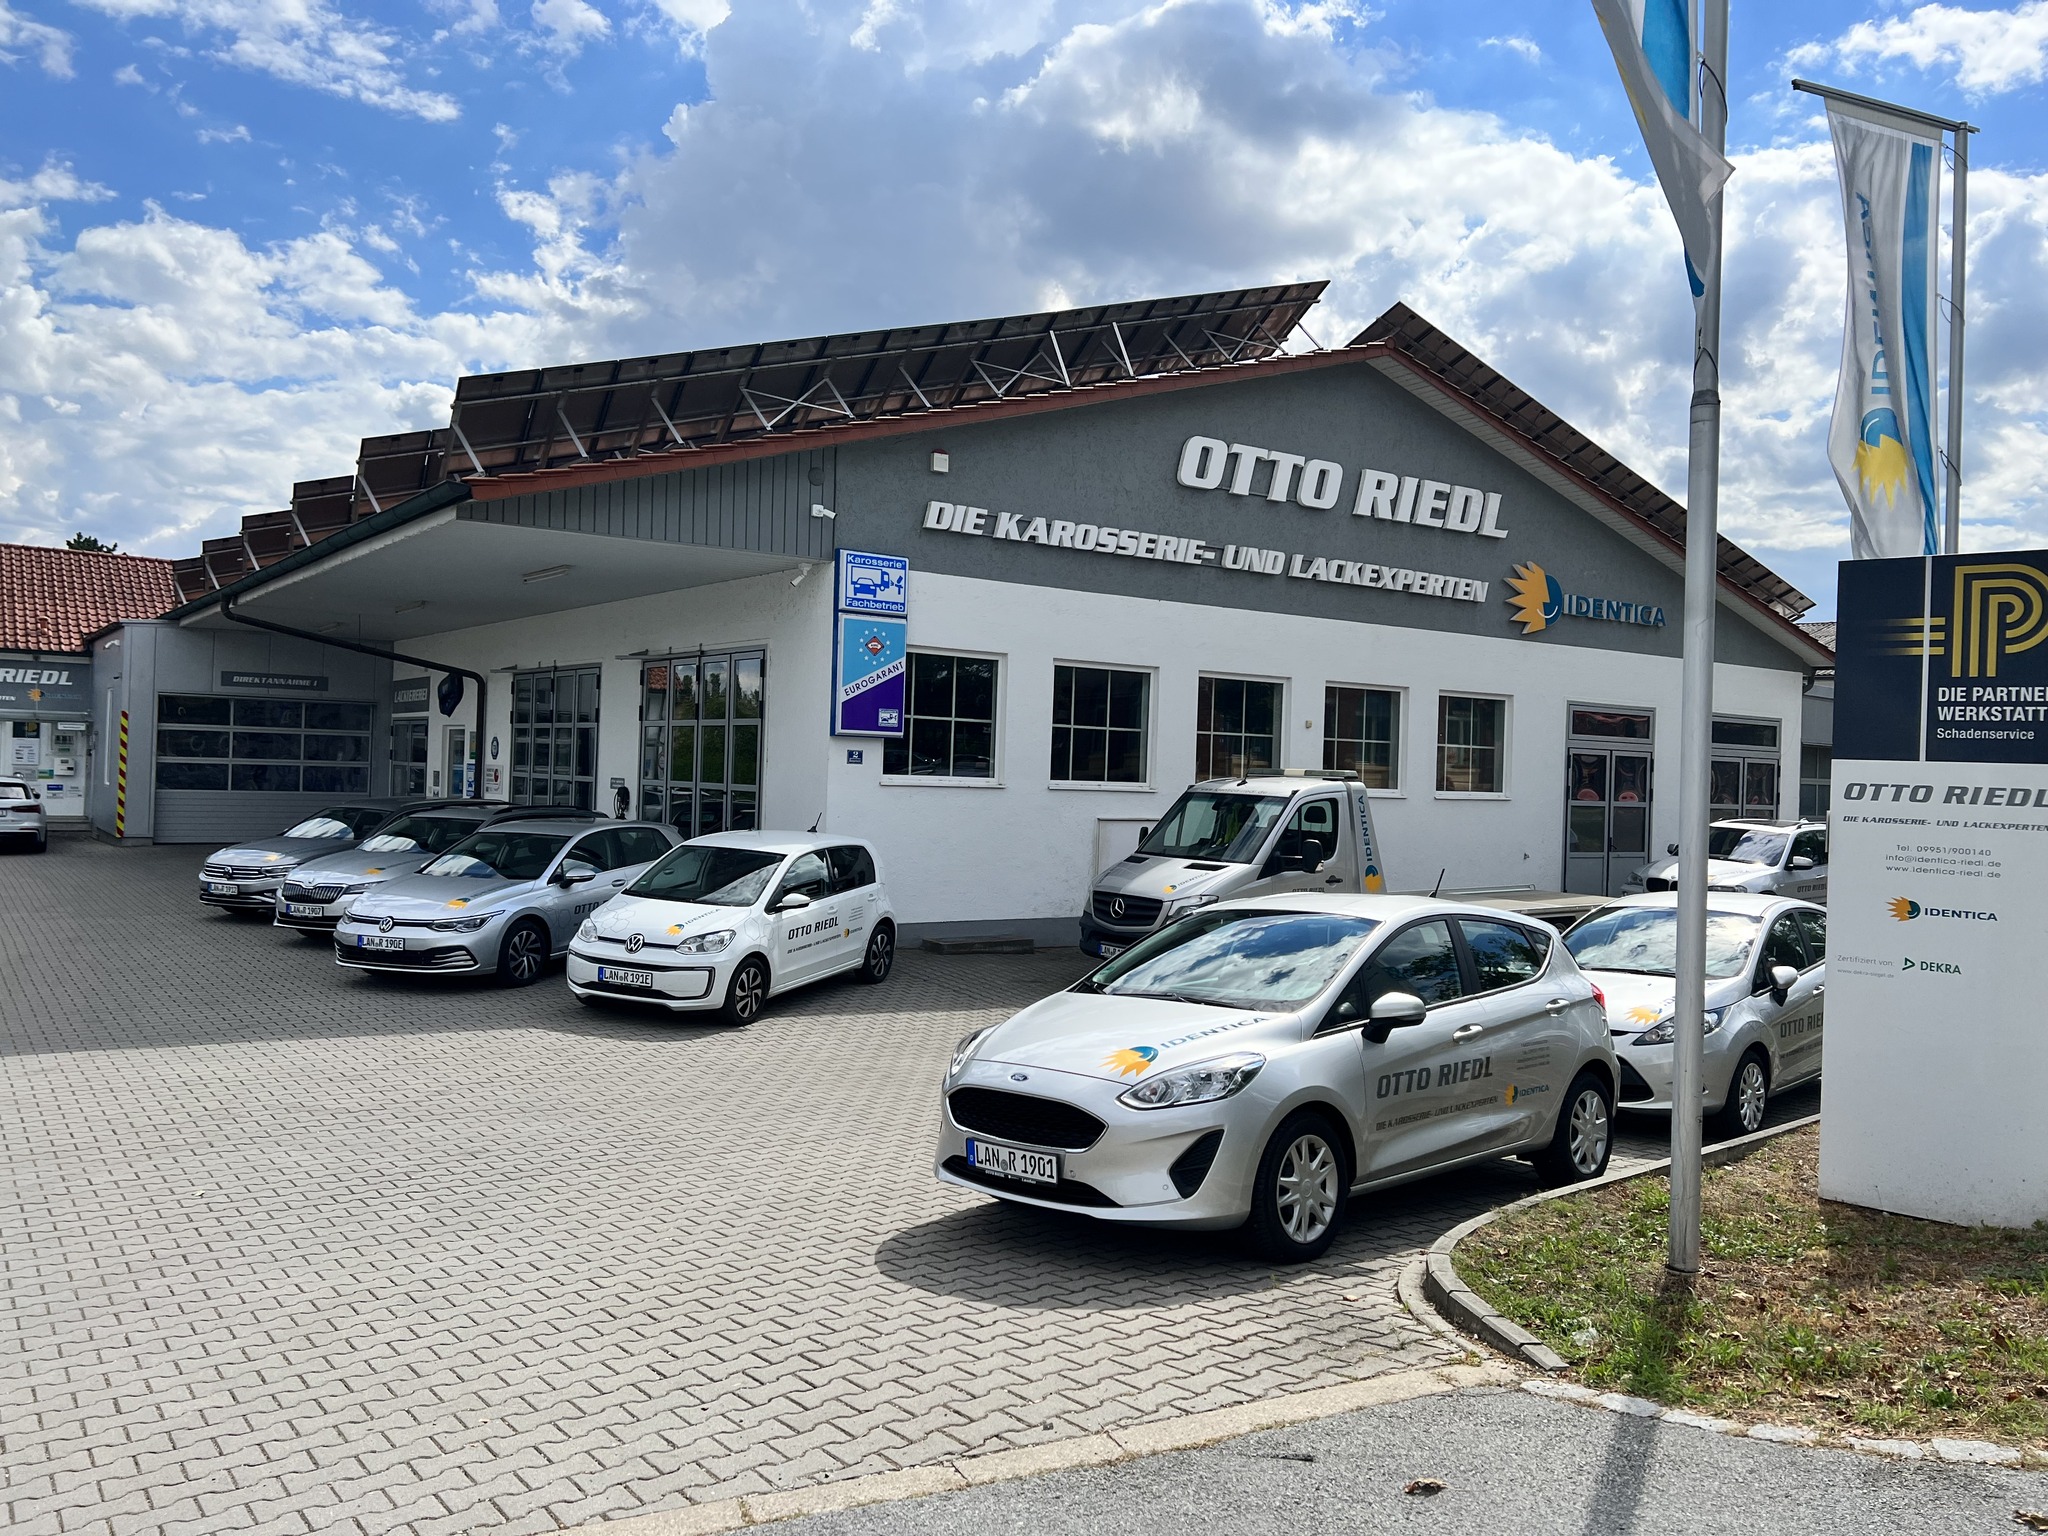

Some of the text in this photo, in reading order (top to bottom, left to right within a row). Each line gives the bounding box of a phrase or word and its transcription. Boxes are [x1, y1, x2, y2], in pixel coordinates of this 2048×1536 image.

[1177, 435, 1510, 539] OTTO RIEDL
[922, 501, 1489, 603] DIE KAROSSERIE- UND LACKEXPERTEN
[846, 598, 905, 612] Fachbetrieb
[1563, 593, 1667, 627] IDENTICA
[0, 668, 73, 685] RIEDL
[232, 675, 312, 687] DIREKTANNAHME
[844, 661, 904, 697] EUROGARANT
[1938, 686, 2048, 702] DIE PARTNE
[1937, 706, 2048, 722] WERKSTATT
[1937, 728, 2035, 740] Schadenservice
[1843, 783, 2048, 808] OTTO RIEDL
[1358, 795, 1373, 861] IDENTICA
[1843, 815, 1859, 823] DIE
[1862, 816, 1931, 826] KAROSSERIE-
[1896, 844, 1991, 856] Tel. 09951/900140
[1885, 854, 2002, 868] info@identica-riedl.de
[1886, 865, 2001, 879] www.identica-riedl.de
[685, 908, 722, 925] IDENTICA
[1924, 907, 1998, 921] IDENTICA
[788, 916, 839, 940] OTTO RIEDL
[362, 937, 375, 947] LAN
[378, 939, 383, 947] R
[1837, 955, 1876, 965] Zertifiziert
[1920, 961, 1962, 975] DEKRA
[604, 969, 619, 981] LAN
[623, 972, 629, 982] R
[630, 973, 650, 985] 191E
[1161, 1017, 1270, 1049] IDENTICA
[1780, 1012, 1823, 1038] OTTO RIE
[1376, 1056, 1493, 1099] OTTO RIEDL
[1519, 1084, 1550, 1097] IDENTICA
[976, 1144, 1000, 1169] LAN
[1008, 1151, 1017, 1172] R
[1021, 1154, 1055, 1180] 1901
